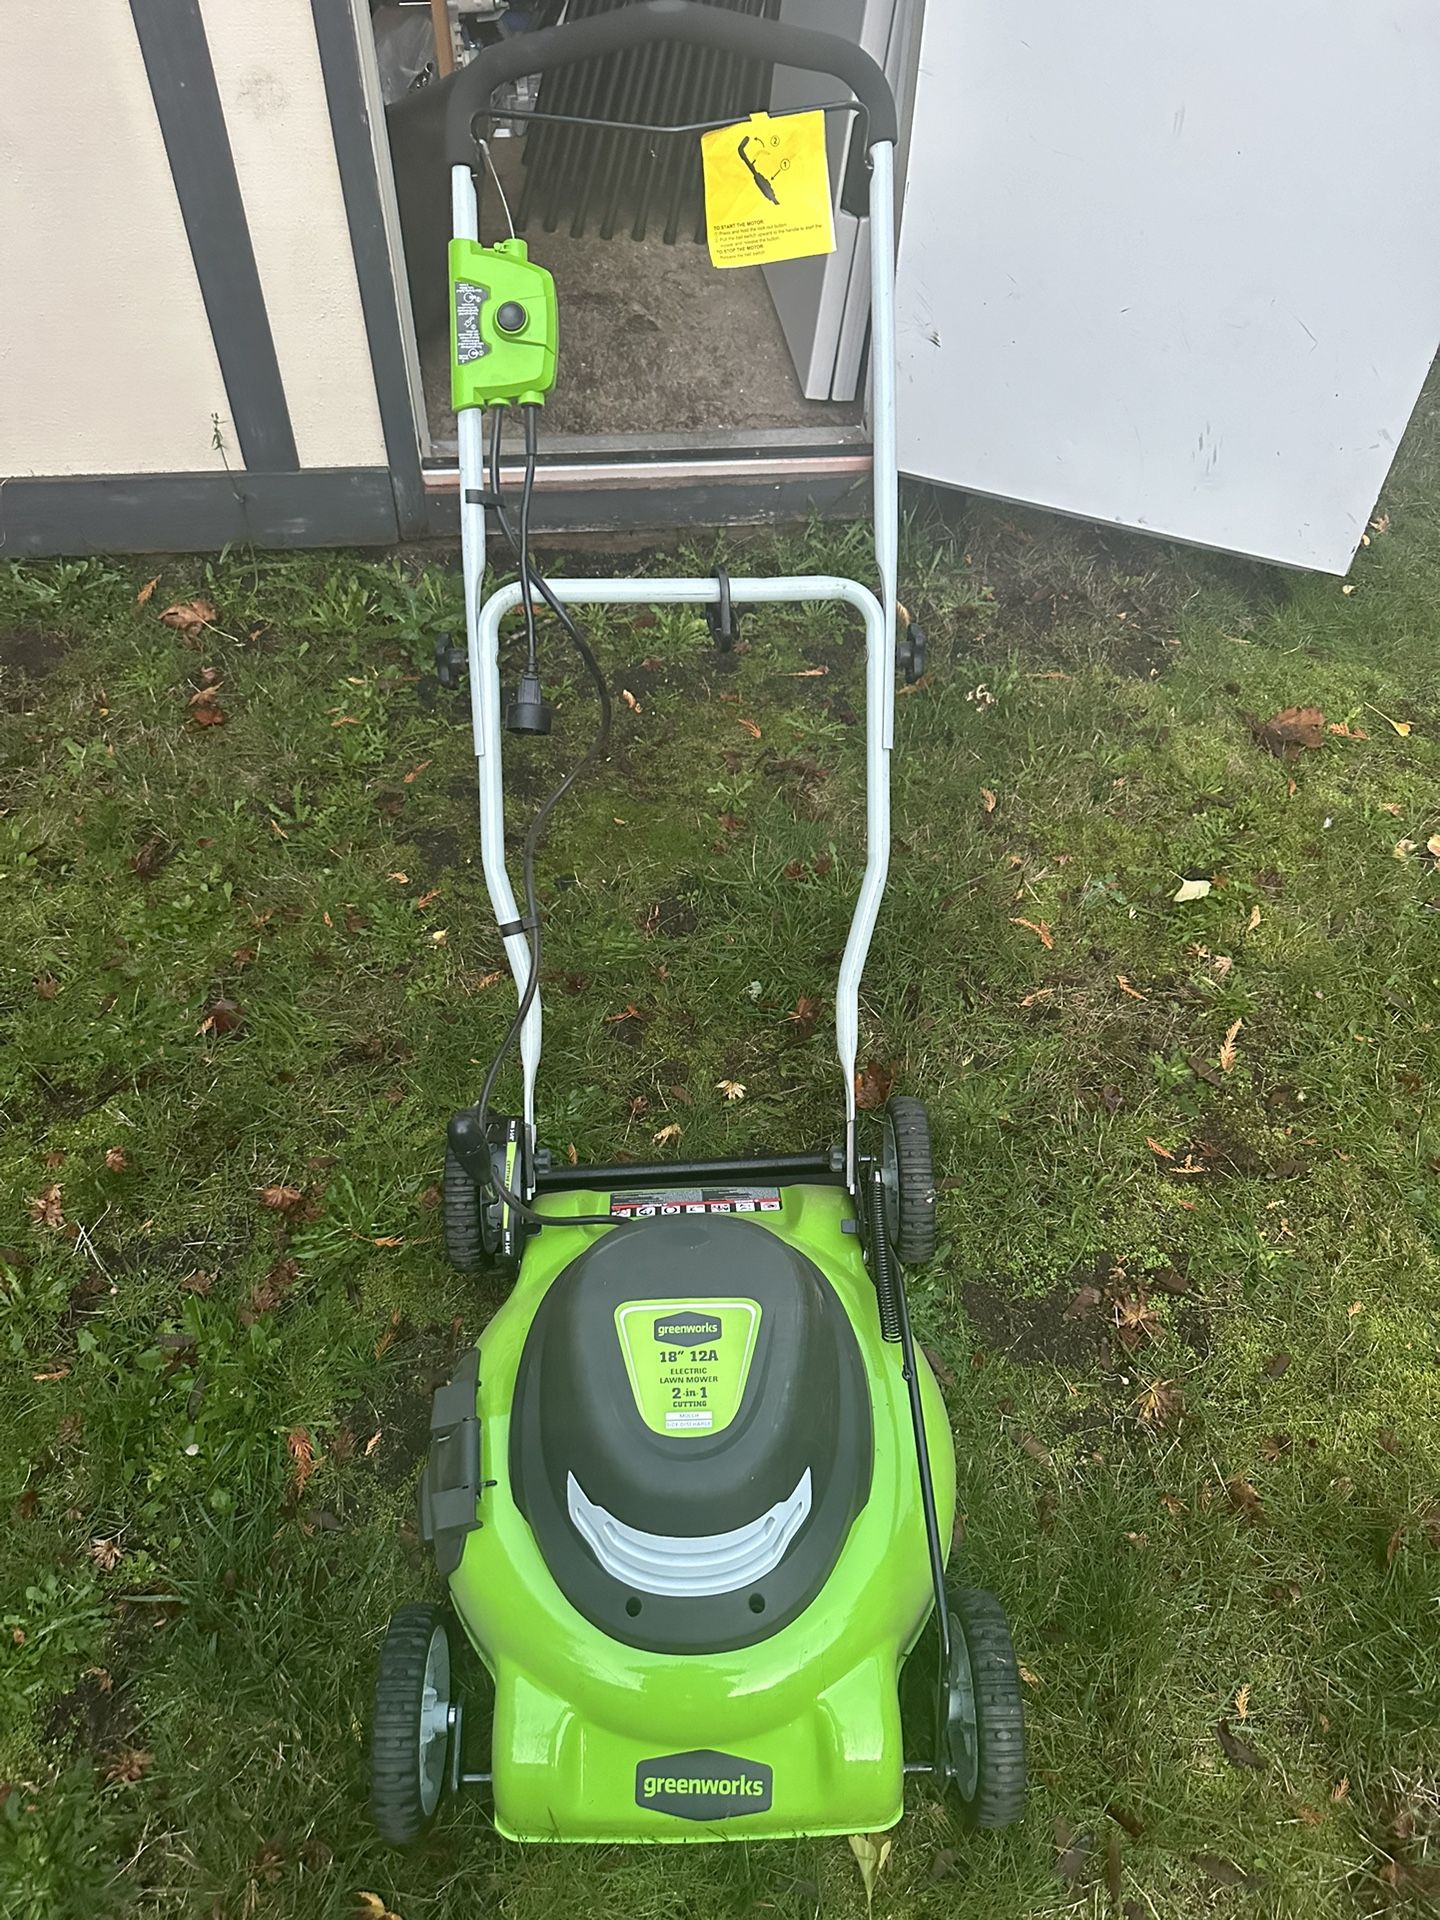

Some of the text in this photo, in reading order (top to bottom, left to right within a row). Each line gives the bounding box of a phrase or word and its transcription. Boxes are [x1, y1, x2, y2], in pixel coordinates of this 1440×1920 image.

[658, 1322, 718, 1336] greenworks
[690, 1350, 718, 1362] 12A
[643, 1774, 764, 1798] greenworks
